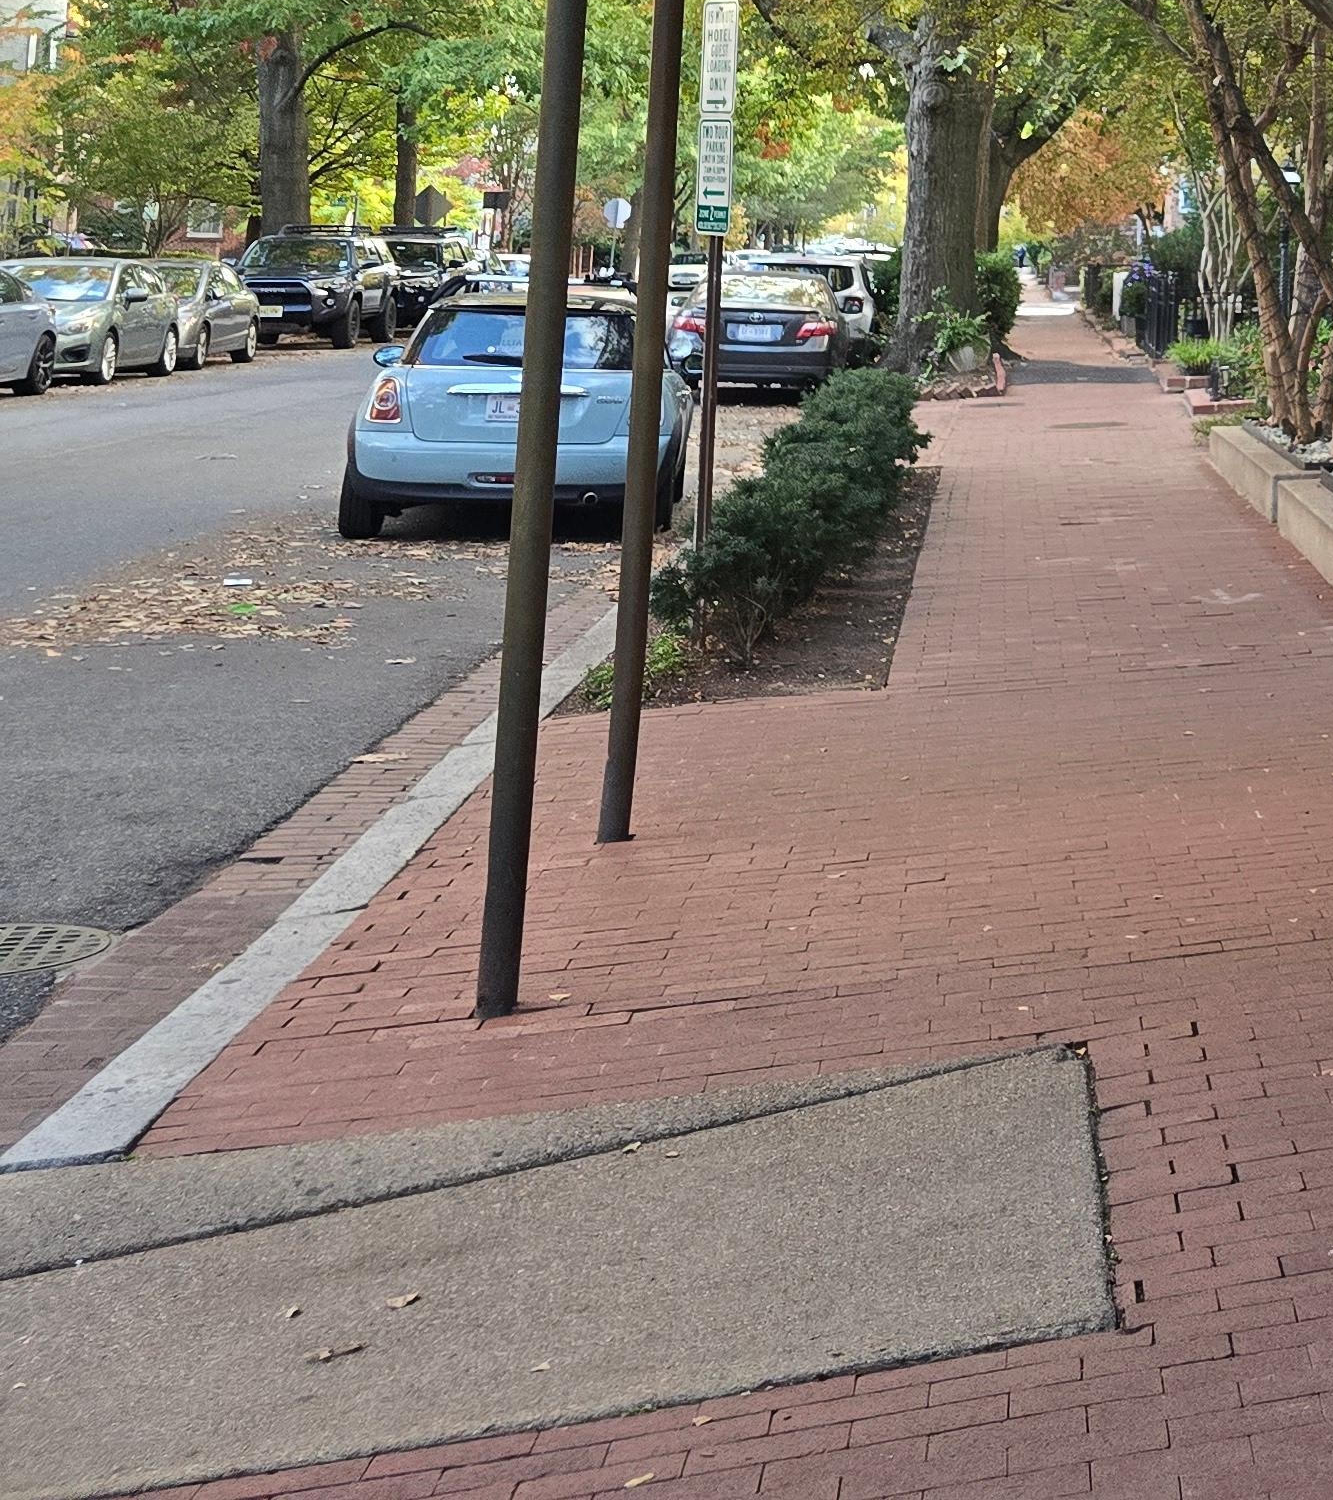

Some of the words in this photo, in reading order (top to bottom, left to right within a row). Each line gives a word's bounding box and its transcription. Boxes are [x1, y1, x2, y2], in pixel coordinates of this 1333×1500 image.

[708, 29, 732, 42] HOTEL
[711, 44, 729, 57] GUEST
[707, 60, 732, 72] LOADING
[709, 78, 727, 90] ONLY
[703, 126, 713, 138] TWO
[706, 142, 726, 153] PARKING
